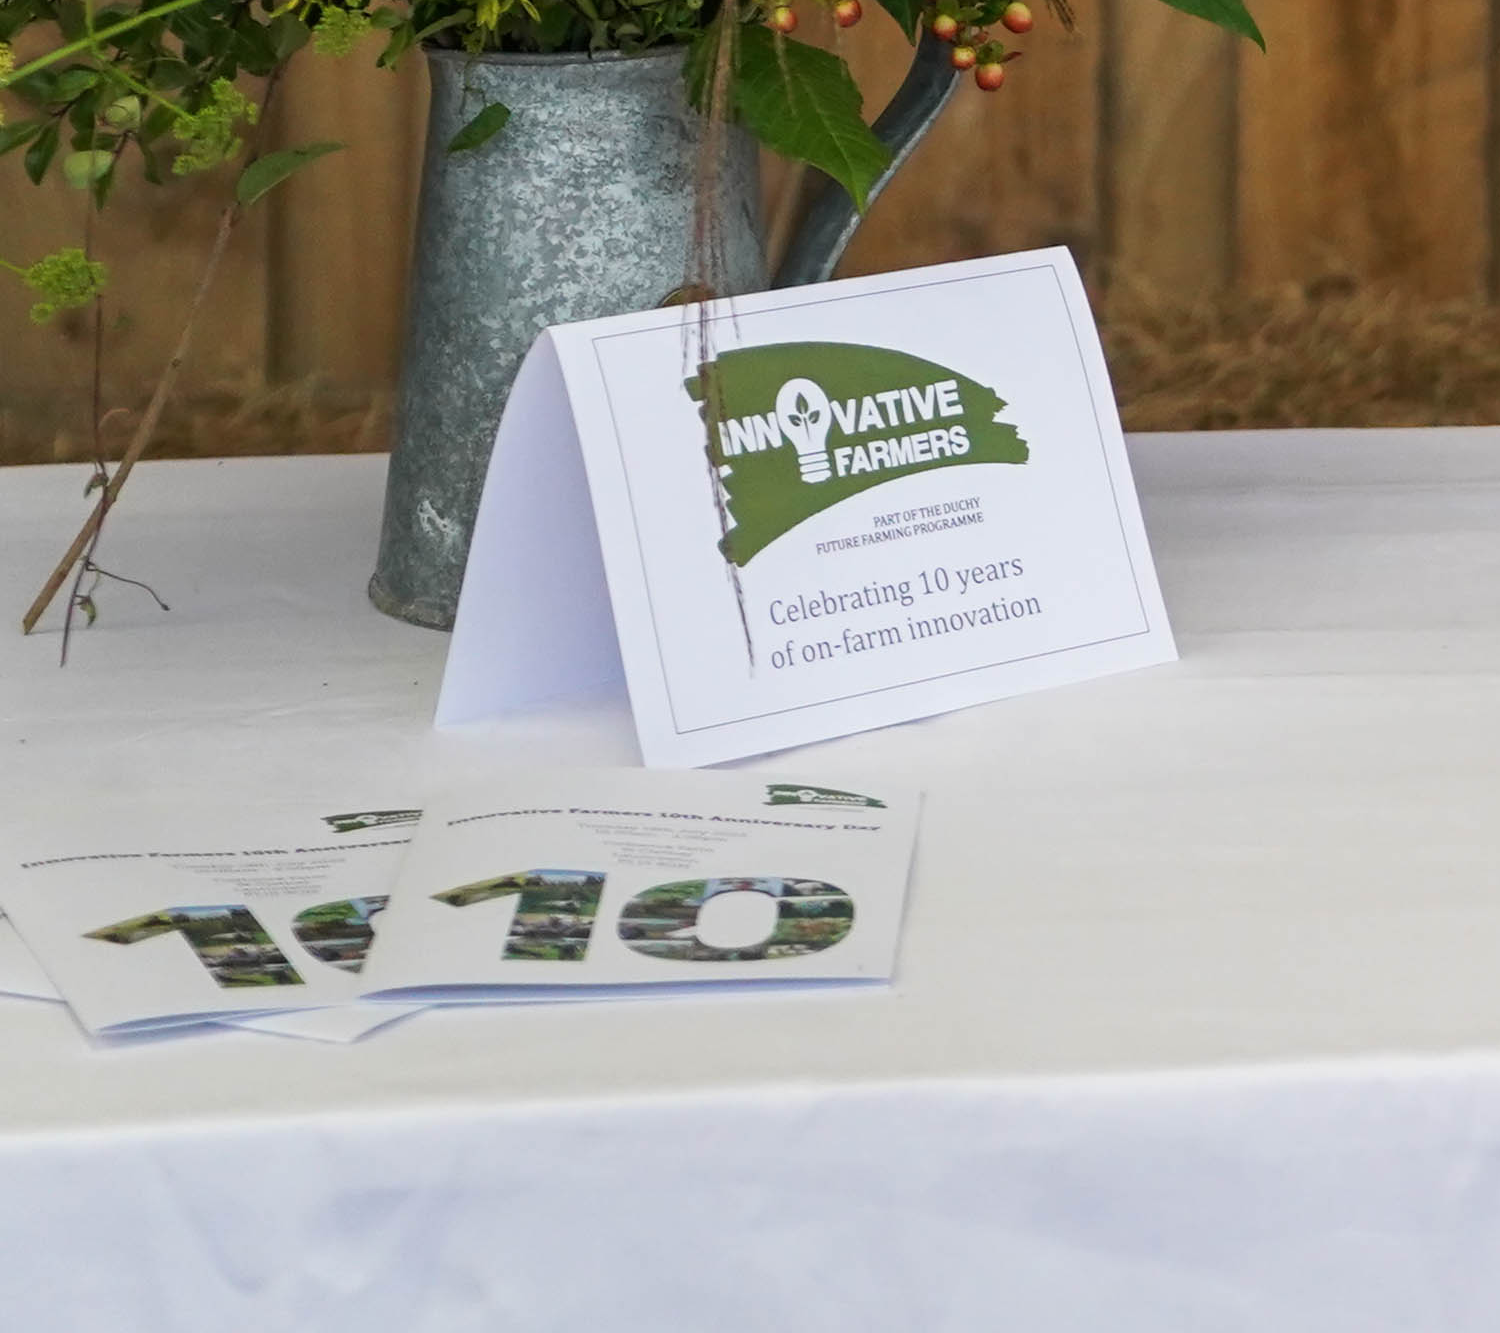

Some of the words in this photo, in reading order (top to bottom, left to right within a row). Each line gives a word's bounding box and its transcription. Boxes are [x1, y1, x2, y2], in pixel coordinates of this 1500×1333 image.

[833, 425, 971, 478] FARMERS
[816, 536, 861, 555] FUTURE
[862, 526, 913, 546] FARMING
[913, 512, 984, 536] PROGRAMME
[873, 512, 900, 528] PART
[903, 509, 917, 523] OF
[919, 504, 942, 519] THE
[943, 497, 981, 514] DUCHY
[769, 581, 914, 626] Celebrating
[918, 566, 950, 596] 10
[955, 557, 1024, 595] years
[771, 640, 795, 669] of
[801, 624, 903, 662] on-farm
[908, 596, 1042, 641] innovation
[447, 807, 564, 827] Innovative
[569, 808, 653, 818] Farmers
[660, 812, 703, 821] 10th
[710, 815, 836, 830] Anniversary
[429, 868, 856, 962] 10
